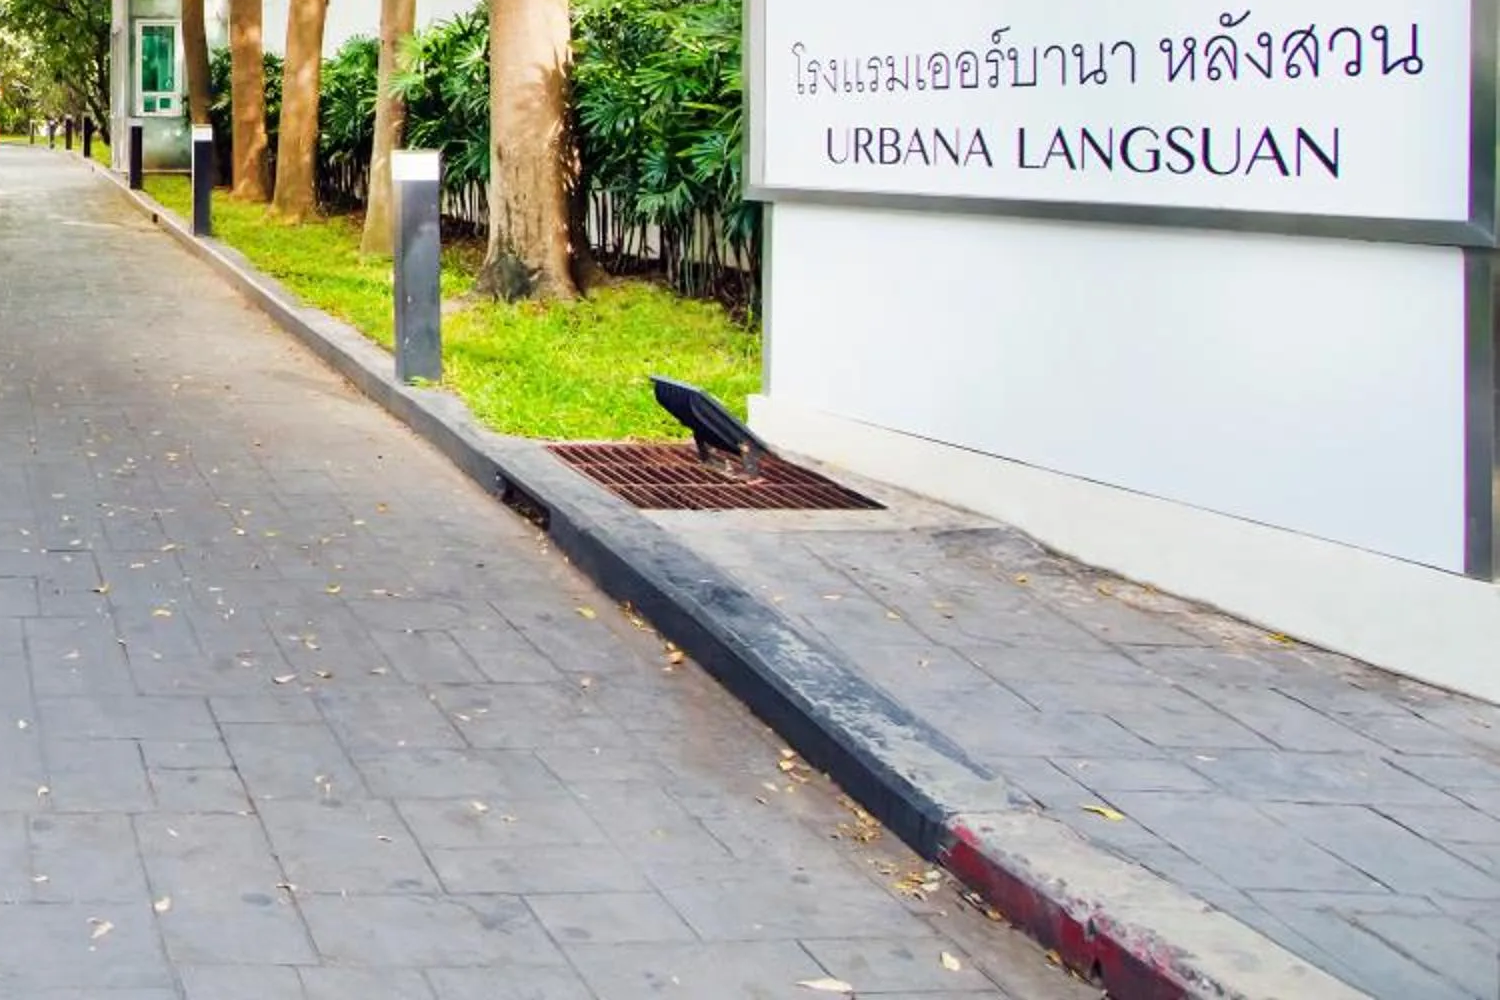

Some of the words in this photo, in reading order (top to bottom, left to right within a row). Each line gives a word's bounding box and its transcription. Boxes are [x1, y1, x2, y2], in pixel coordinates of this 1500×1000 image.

[790, 25, 1136, 96] โรงแรมเออร์บานา
[1160, 10, 1424, 82] หลังสวน
[826, 127, 993, 168] URBANA
[1017, 126, 1341, 179] LANGSUAN
